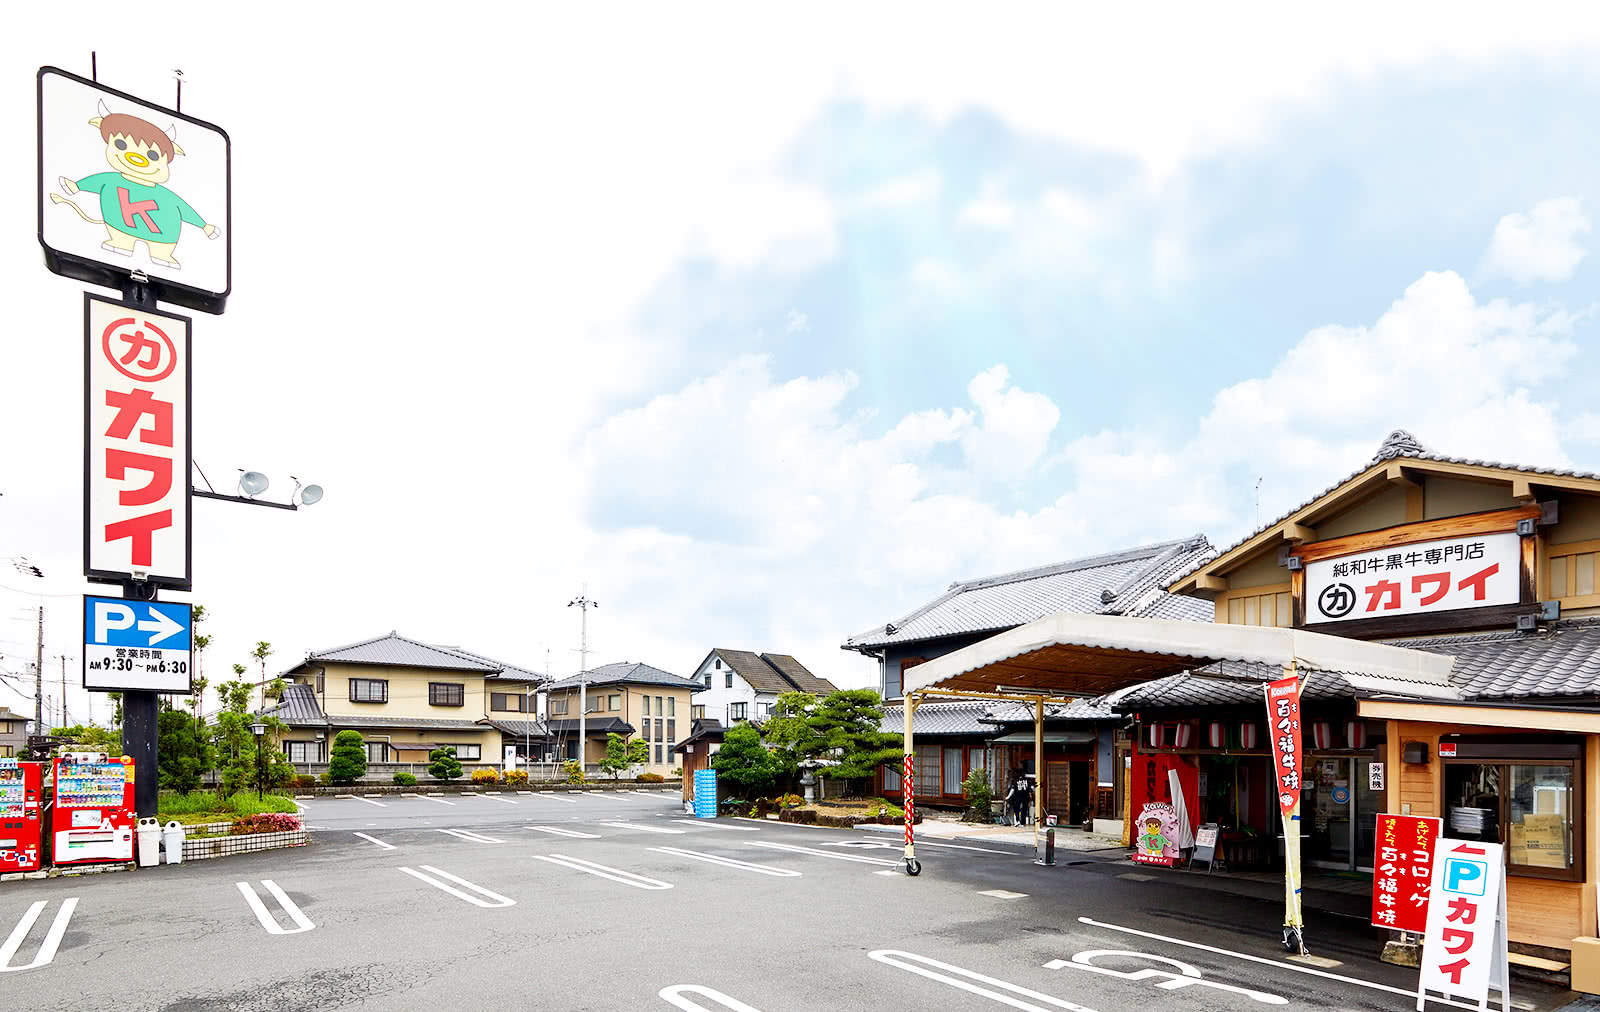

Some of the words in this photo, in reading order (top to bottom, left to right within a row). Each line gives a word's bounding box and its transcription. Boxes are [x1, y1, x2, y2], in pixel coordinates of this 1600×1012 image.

[117, 187, 162, 234] K
[104, 387, 174, 568] カワイ
[1332, 542, 1486, 578] 純和牛黒牛専門店
[1365, 562, 1500, 613] カワイ
[95, 602, 136, 644] P
[103, 657, 133, 671] 9:30
[158, 660, 187, 674] 6:30
[1448, 860, 1482, 891] P
[1438, 896, 1478, 985] カワイ
